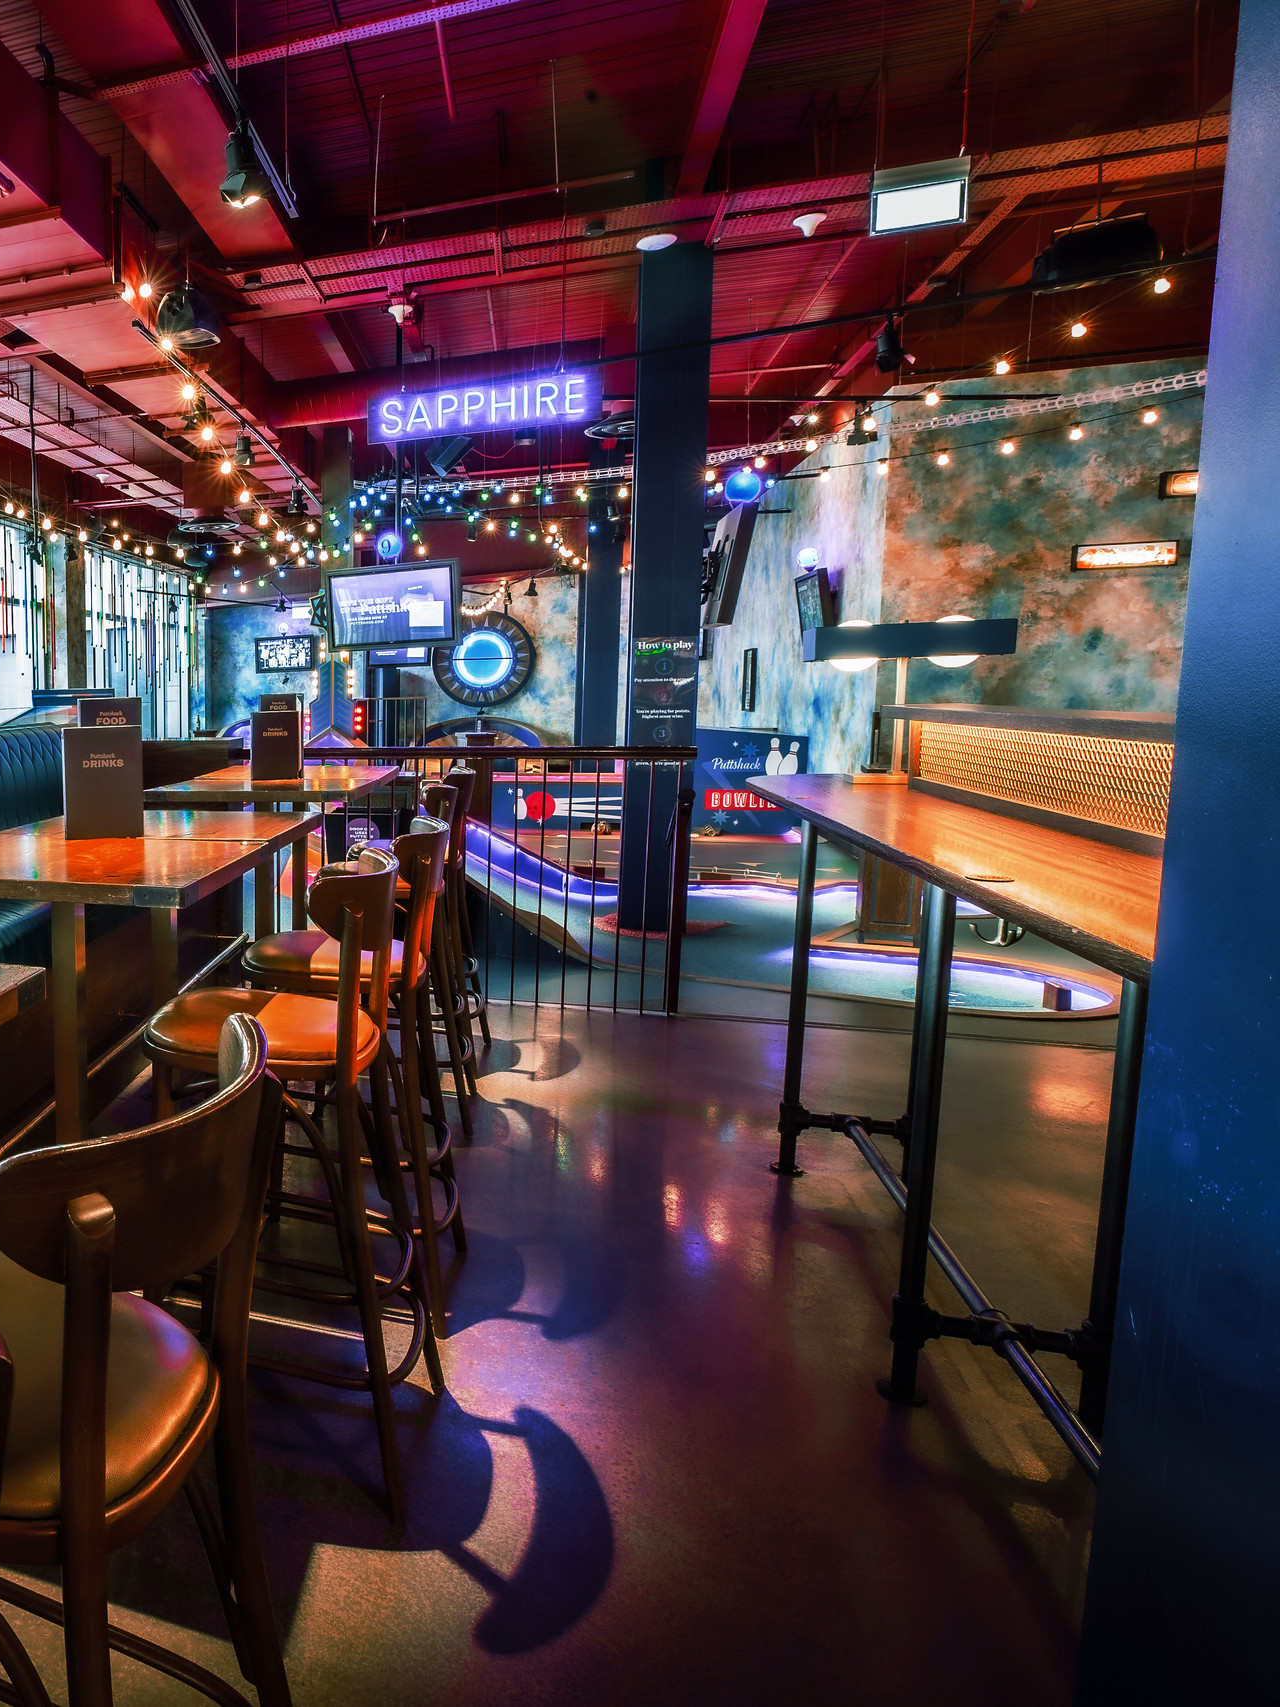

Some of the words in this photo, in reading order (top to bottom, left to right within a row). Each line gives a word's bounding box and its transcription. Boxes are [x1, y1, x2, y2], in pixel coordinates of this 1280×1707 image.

[381, 379, 585, 434] SAPPHIRE
[381, 539, 391, 553] 9
[637, 641, 660, 650] How
[673, 640, 694, 651] play
[662, 662, 667, 670] 1
[660, 693, 667, 701] 2
[95, 716, 127, 725] FOOD
[659, 729, 666, 738] 3
[82, 758, 125, 769] DRINKS
[711, 757, 762, 770] Puttshack
